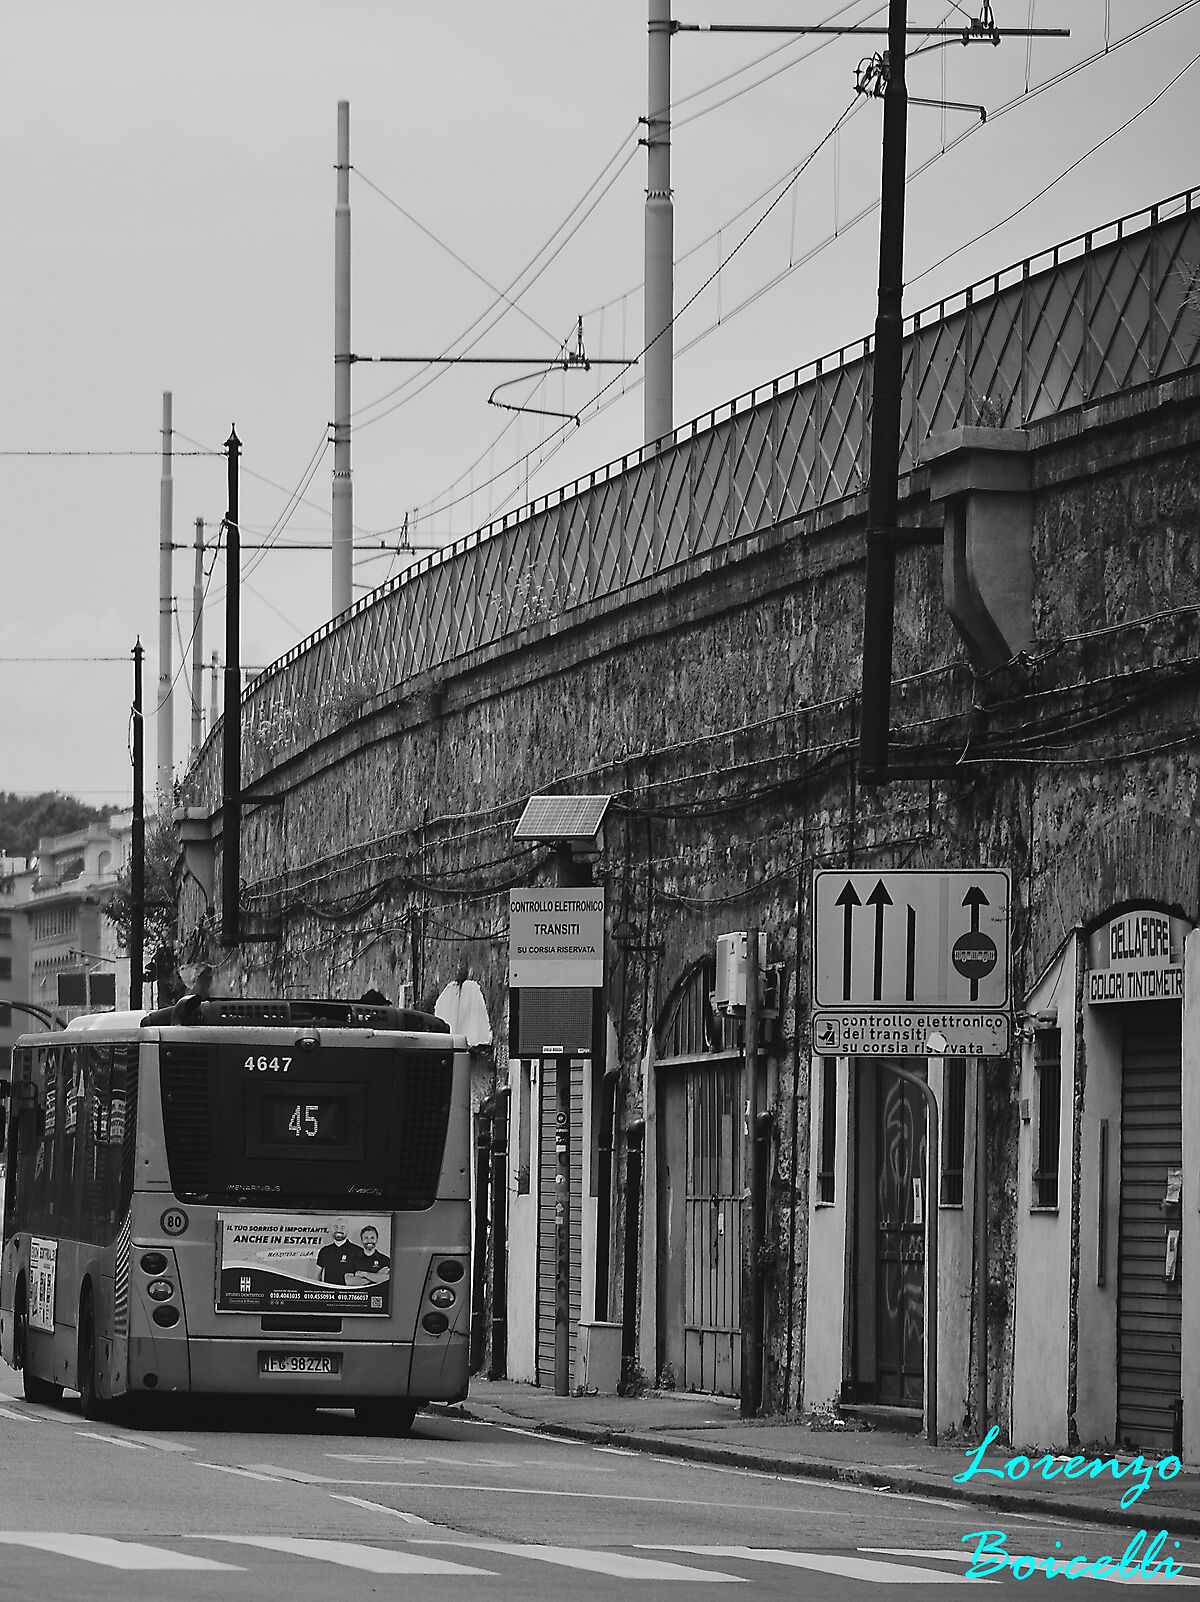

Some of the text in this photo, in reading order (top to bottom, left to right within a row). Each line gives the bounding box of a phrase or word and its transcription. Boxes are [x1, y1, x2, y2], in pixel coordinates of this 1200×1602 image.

[510, 900, 604, 912] CONTROLLO ELETTRONICO
[534, 922, 580, 936] TRANSITI
[1111, 917, 1169, 960] DELLAFIORE
[517, 946, 596, 954] SU CORSIA RISERVATA
[1091, 972, 1124, 1000] COLORI
[842, 1016, 1003, 1028] controllo elettronico
[843, 1028, 927, 1040] dei transiti
[842, 1043, 858, 1052] su
[862, 1042, 908, 1053] corsia
[244, 1056, 292, 1072] 4647
[288, 1105, 319, 1137] 45
[168, 1216, 182, 1228] 80
[233, 1235, 322, 1244] ANCHE IN ESTATE!
